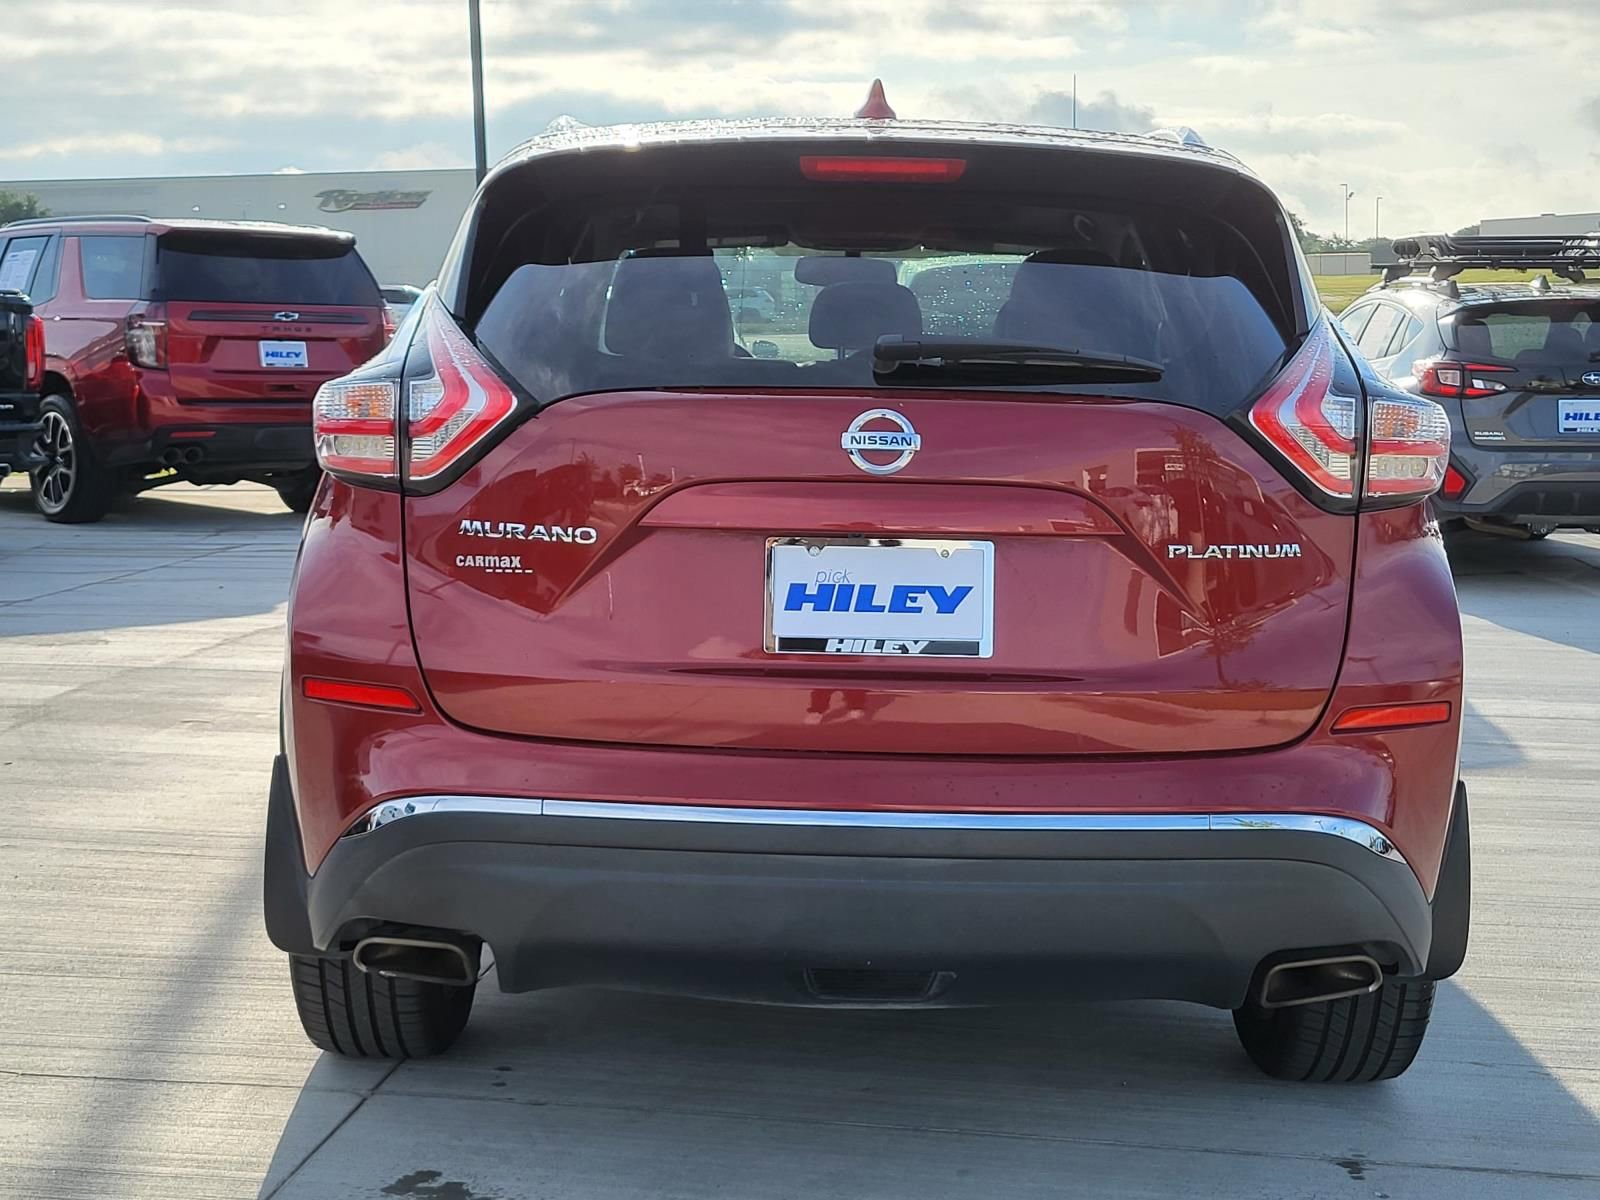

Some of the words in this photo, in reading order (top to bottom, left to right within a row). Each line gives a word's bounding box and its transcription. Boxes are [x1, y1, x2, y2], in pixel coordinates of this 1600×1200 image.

[850, 435, 913, 447] NISSAN
[458, 519, 598, 545] MURANO
[1168, 543, 1302, 559] PLATINUM
[814, 567, 853, 585] pick
[784, 583, 974, 614] HILEY
[825, 638, 930, 654] HILEY
